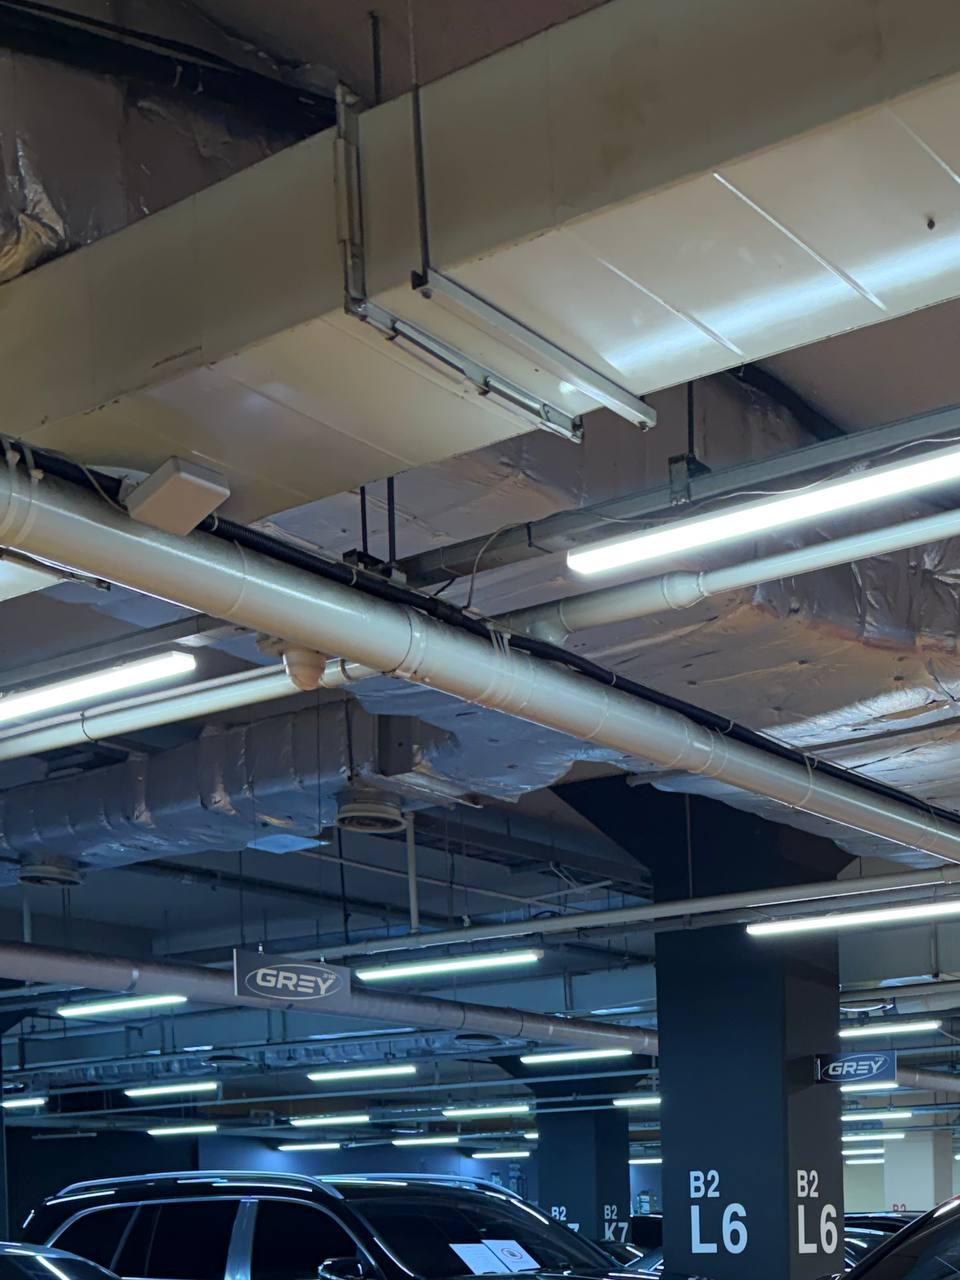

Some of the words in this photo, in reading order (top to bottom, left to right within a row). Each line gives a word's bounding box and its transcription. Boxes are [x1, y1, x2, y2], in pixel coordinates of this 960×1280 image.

[257, 968, 334, 995] GREY
[829, 1059, 884, 1075] GREY
[690, 1170, 720, 1198] B2
[797, 1170, 819, 1198] B2
[551, 1206, 567, 1220] B2
[604, 1205, 618, 1219] B2
[604, 1222, 629, 1243] K7
[690, 1203, 748, 1254] L6
[798, 1203, 838, 1254] L6
